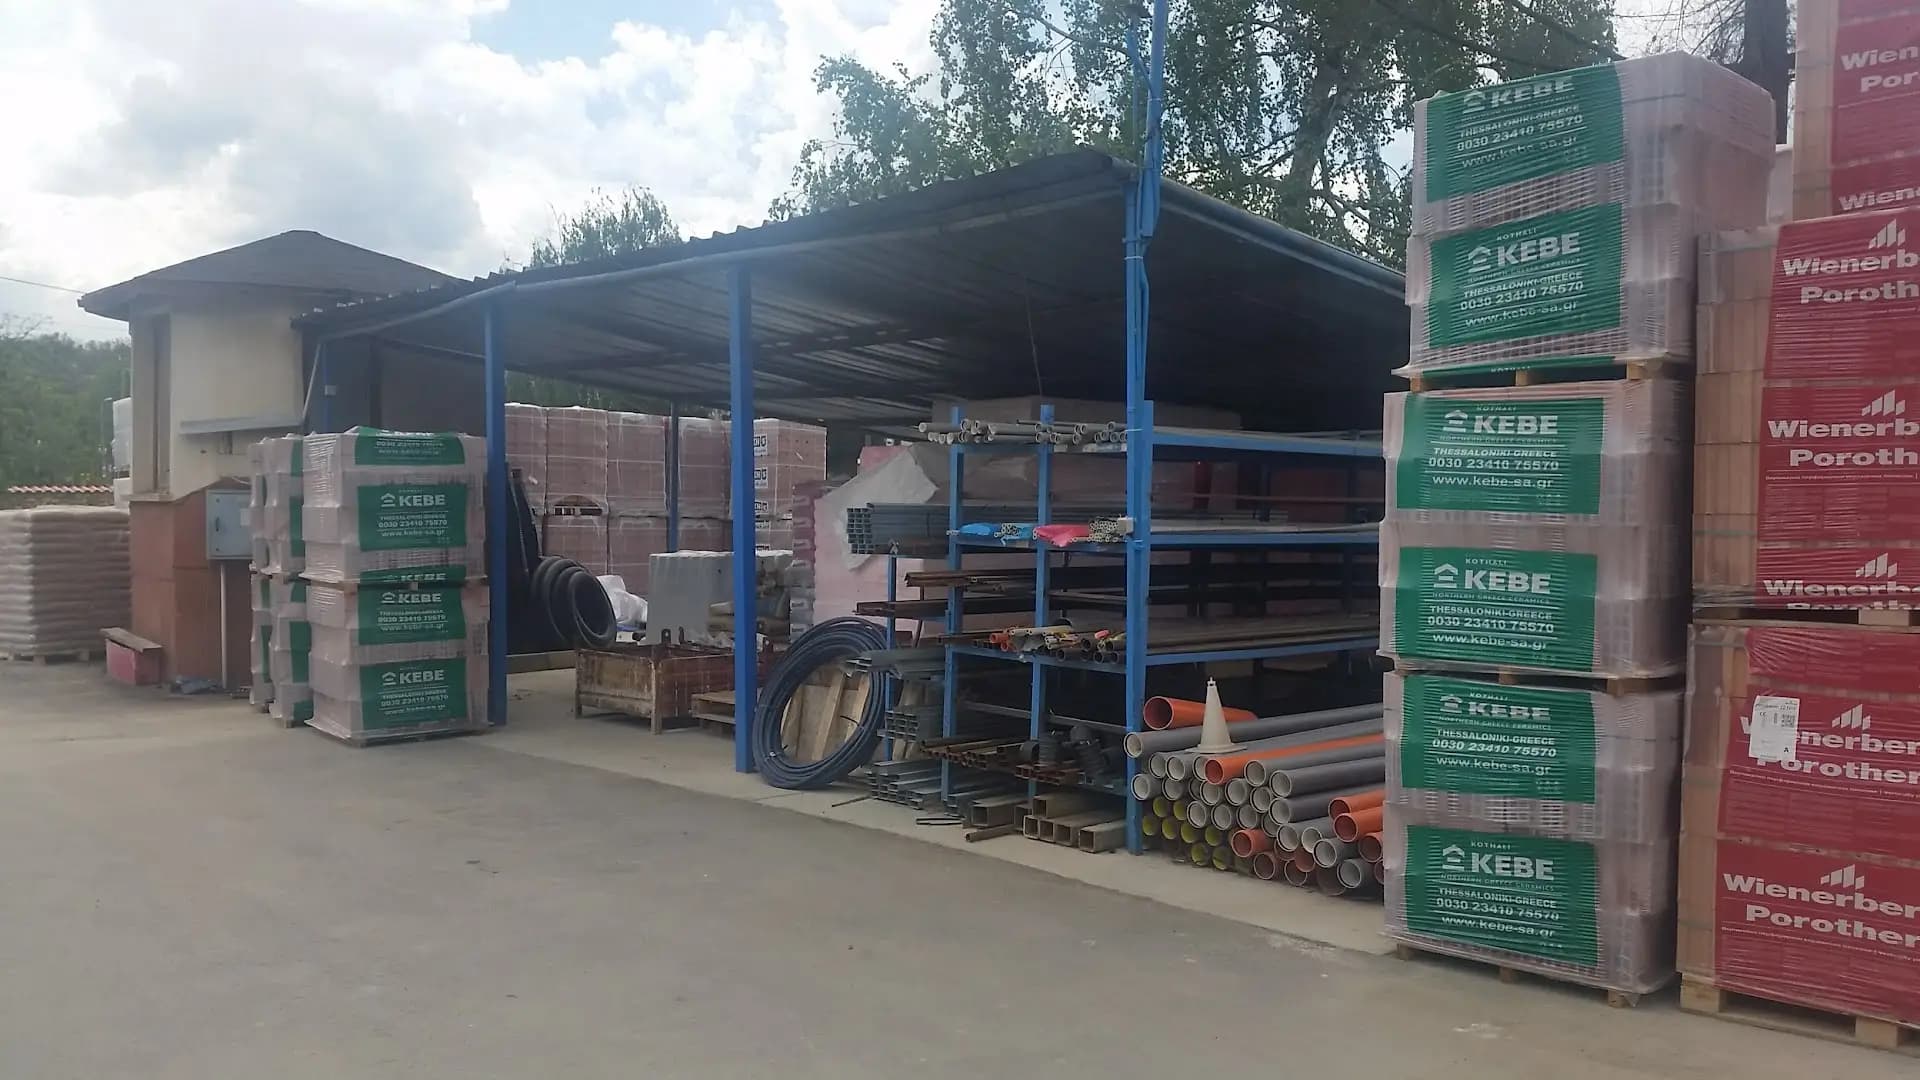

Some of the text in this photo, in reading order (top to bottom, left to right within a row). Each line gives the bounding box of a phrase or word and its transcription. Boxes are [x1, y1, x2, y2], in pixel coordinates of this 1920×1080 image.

[1491, 77, 1575, 108] KEBE
[1457, 136, 1489, 152] 0030
[1497, 232, 1581, 267] KEBE
[1783, 249, 1920, 276] Wienerb
[1460, 297, 1492, 311] 0030
[1540, 281, 1584, 296] 75570
[1800, 280, 1920, 304] Poroth
[1473, 415, 1559, 435] KEBE
[1768, 418, 1920, 438] Wienerb
[1433, 447, 1558, 458] THESSALONIKI-GREECE
[1789, 447, 1919, 467] Poroth
[1428, 457, 1559, 471] 0030 23410 75570
[1432, 475, 1554, 489] www.kebe-sa.gr
[399, 494, 446, 507] KEBE
[401, 573, 446, 581] KEBE
[1464, 569, 1551, 595] KEBE
[398, 593, 442, 604] KEBE
[1429, 605, 1553, 620] THESSALONIKI-GREECE
[1427, 616, 1555, 634] 0030 23410 75570
[400, 669, 445, 684] KEBE
[1468, 701, 1551, 720] KEBE
[1437, 728, 1556, 746] THESSALONIKI-GREECE
[1432, 739, 1557, 758] 0030 23410 75570
[1436, 757, 1552, 776] www.kebe-sa.gr
[1471, 852, 1554, 881] KEBE
[1439, 887, 1558, 909] THESSALONIKI-GREECE
[1723, 873, 1920, 919] Wienerber
[1436, 898, 1469, 910] 0030
[1472, 902, 1514, 916] 23410
[1746, 904, 1920, 948] Porother
